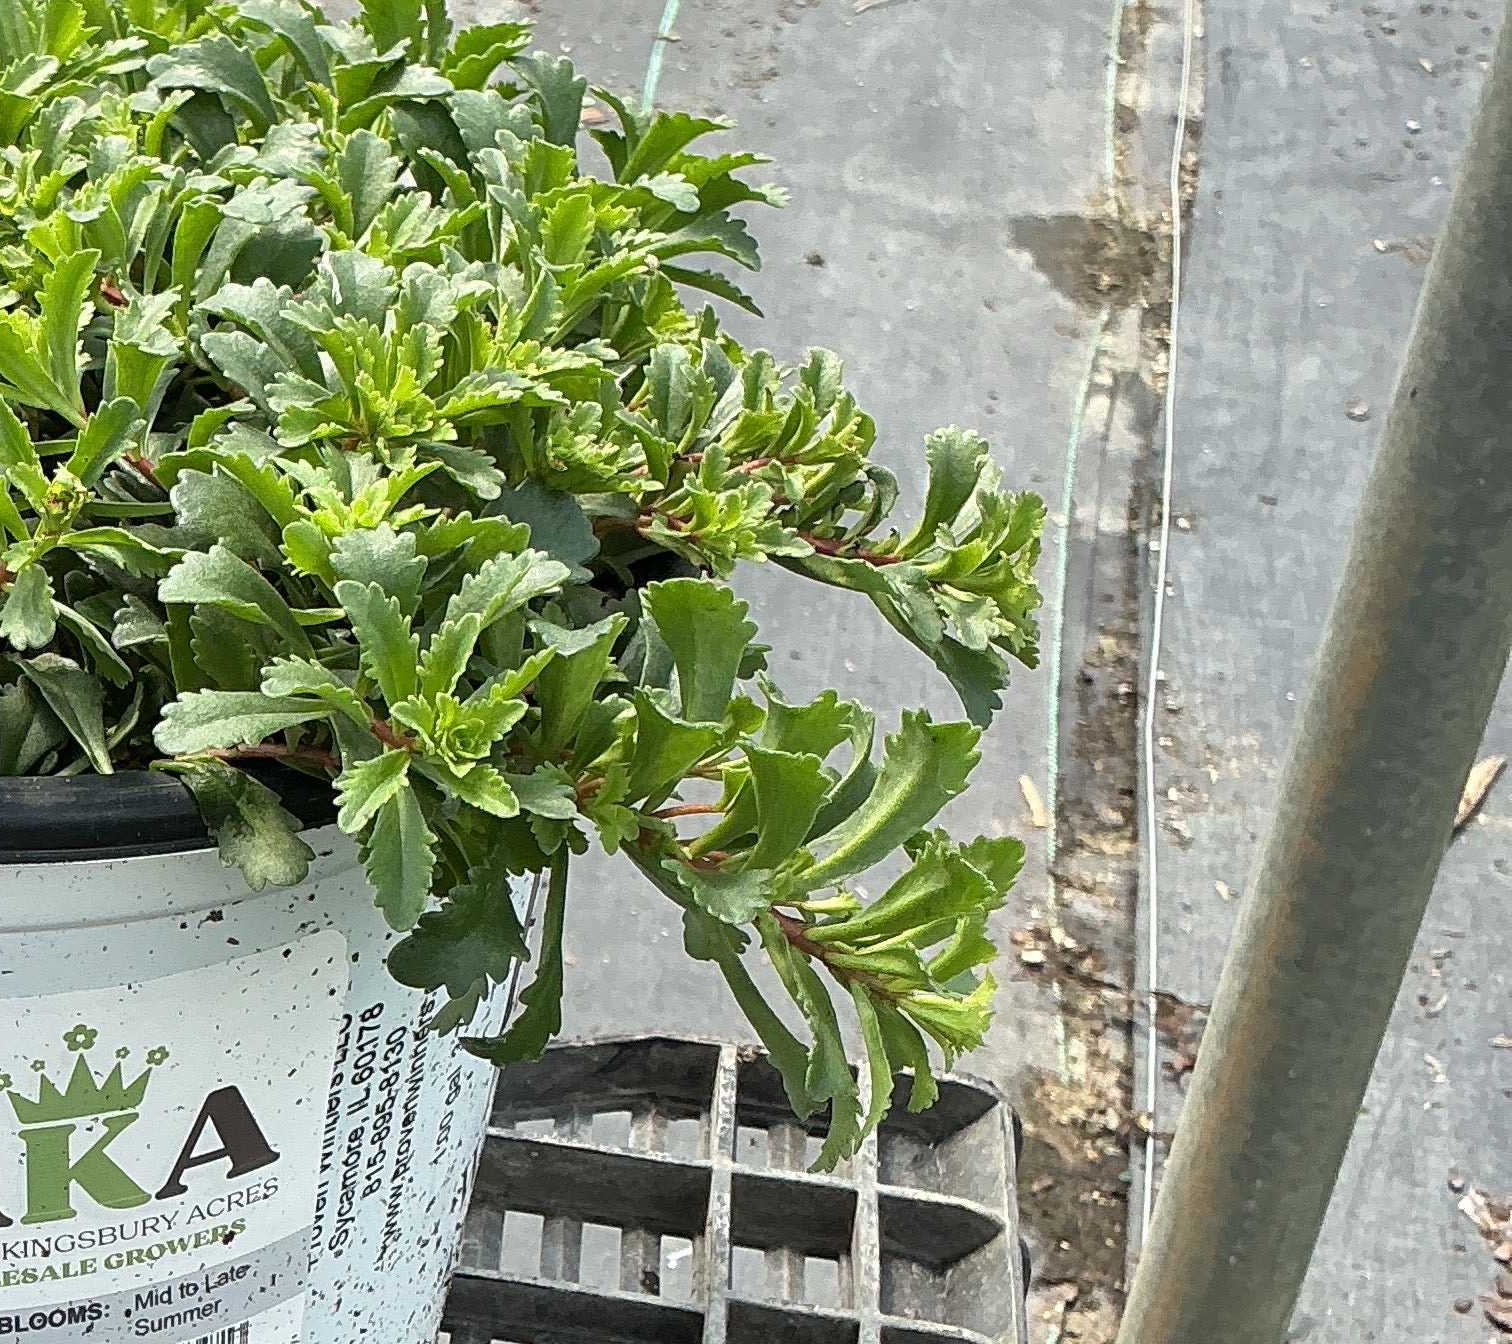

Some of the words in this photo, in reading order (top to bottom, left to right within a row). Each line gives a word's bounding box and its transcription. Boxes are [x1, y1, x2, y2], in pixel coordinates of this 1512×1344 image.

[351, 1002, 385, 1086] 60178
[347, 1086, 371, 1116] IL
[362, 1025, 407, 1199] 815-895-8130
[2, 1211, 178, 1261] KINGSBURY
[186, 1176, 279, 1226] ACRES
[104, 1218, 247, 1271] GROWERS
[135, 1285, 172, 1311] Mid
[179, 1281, 199, 1299] to
[205, 1265, 249, 1294] Late
[135, 1299, 222, 1337] Summer
